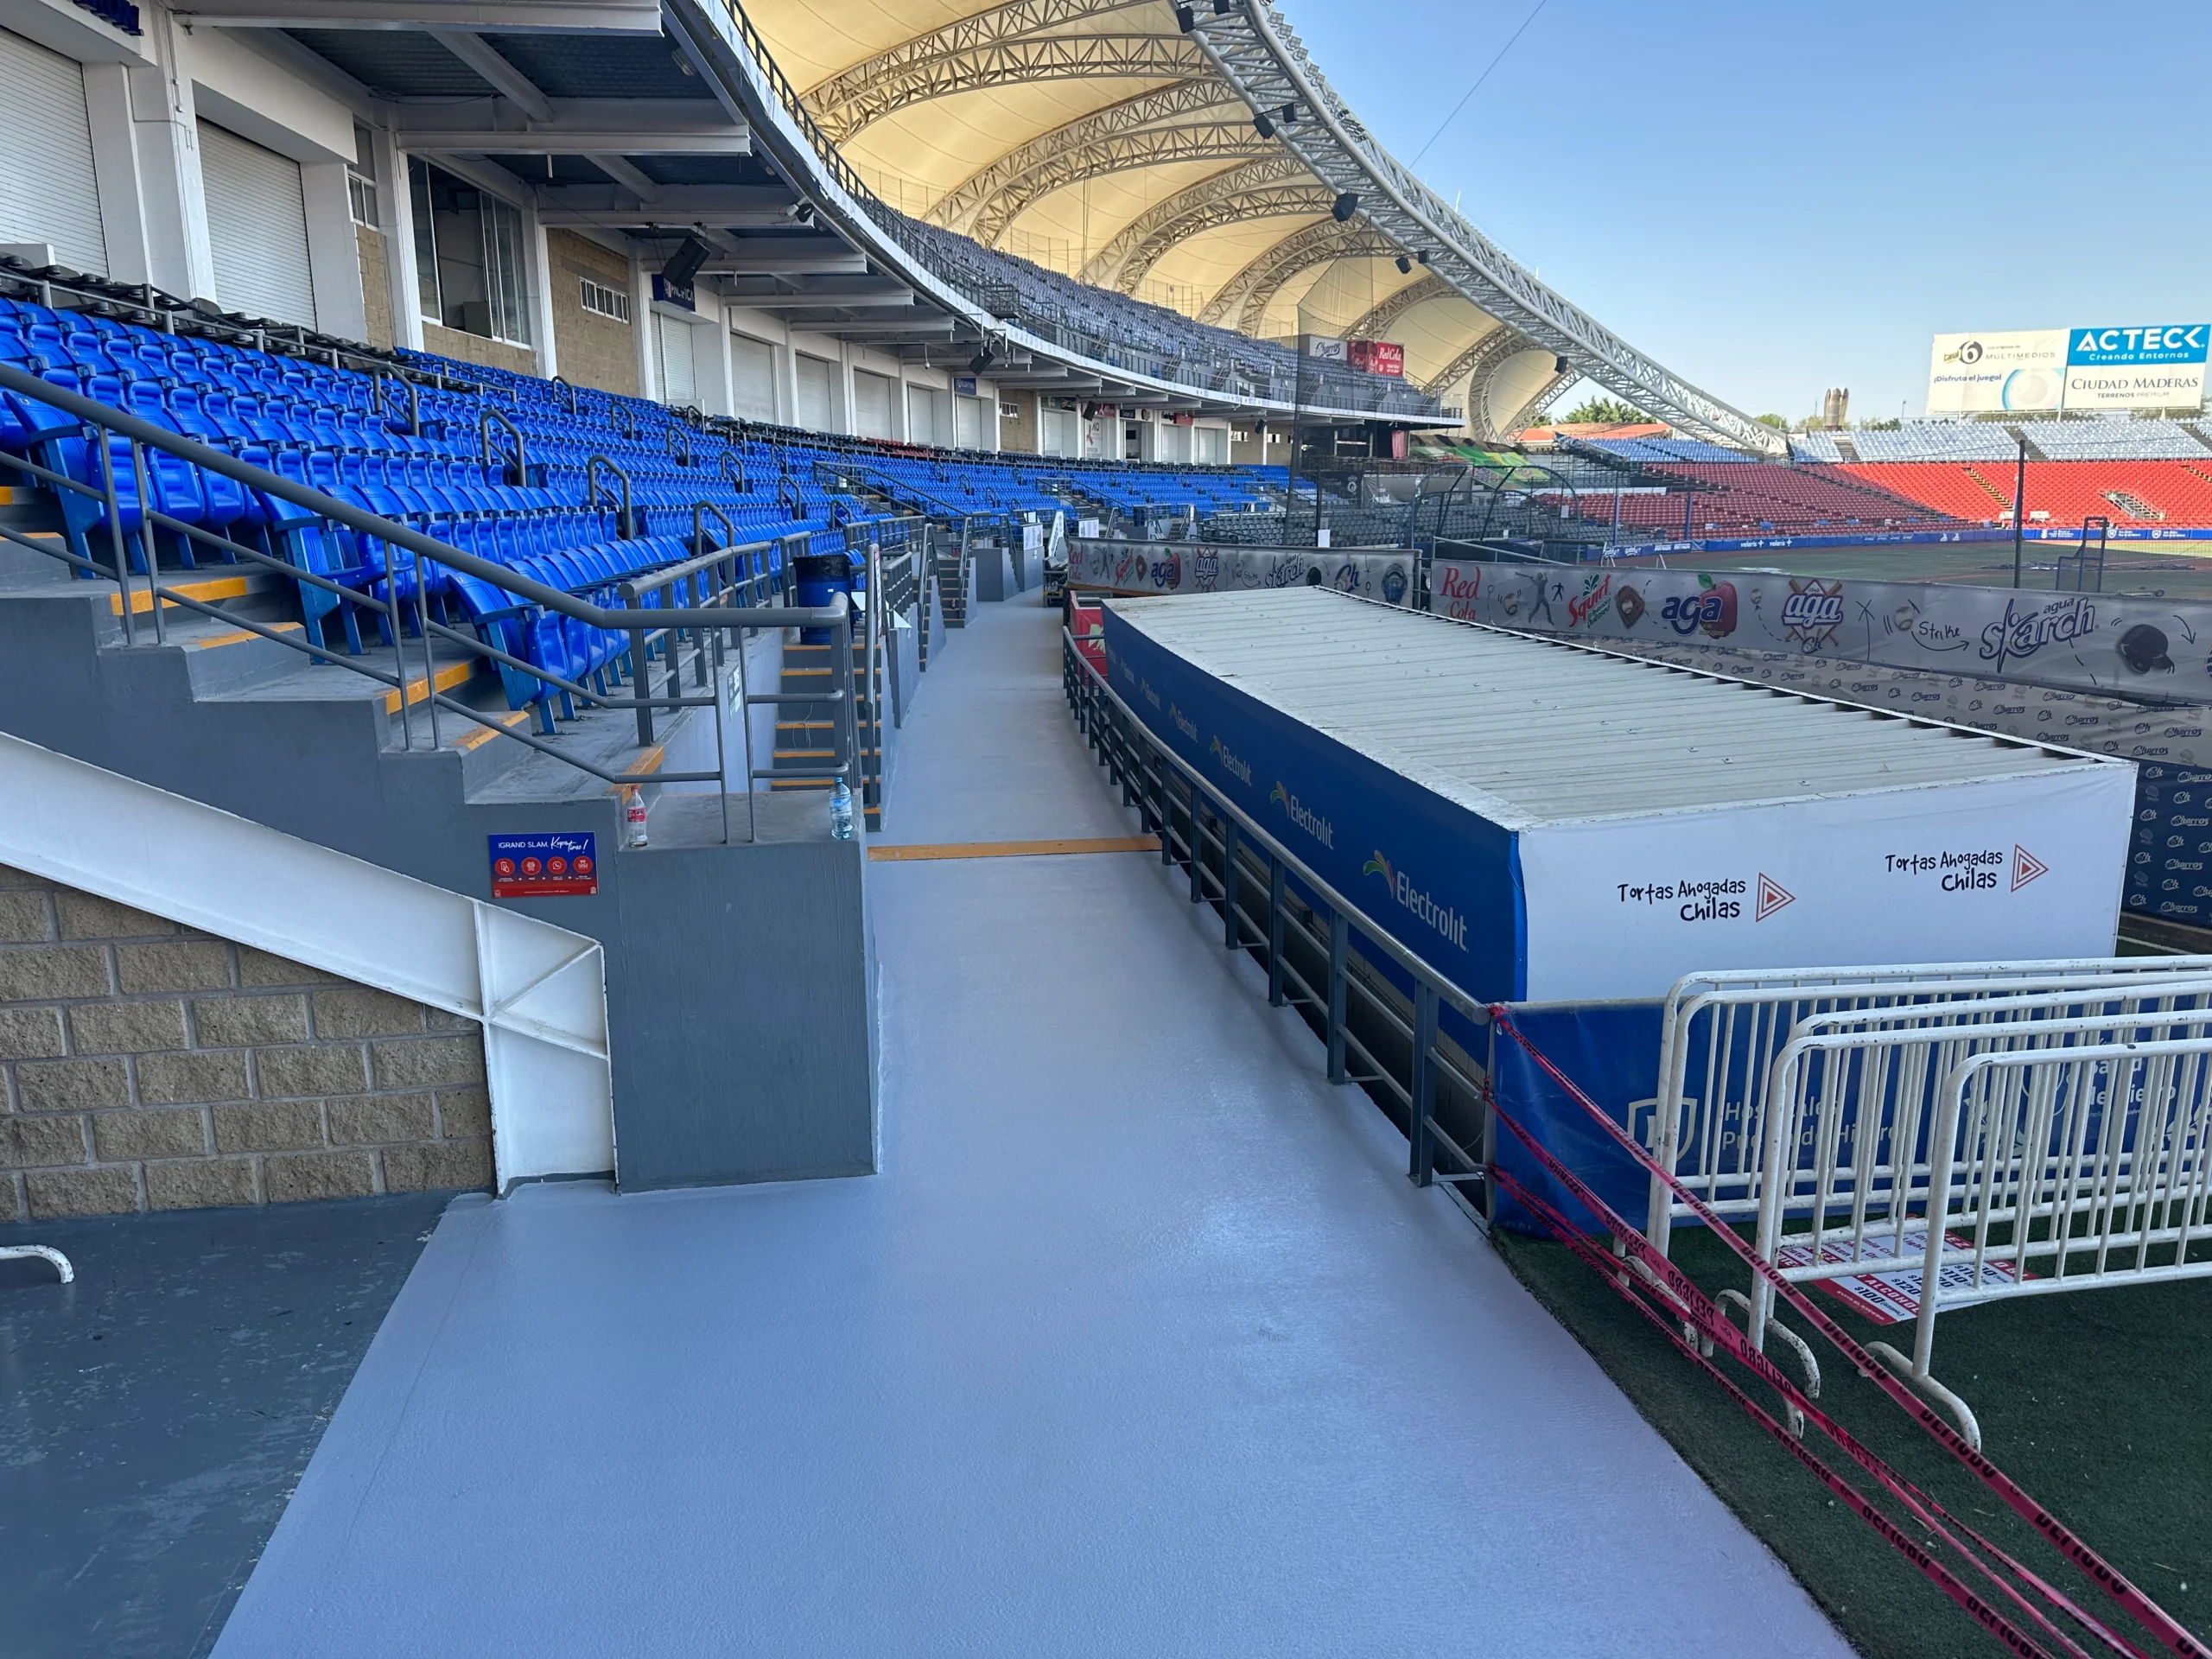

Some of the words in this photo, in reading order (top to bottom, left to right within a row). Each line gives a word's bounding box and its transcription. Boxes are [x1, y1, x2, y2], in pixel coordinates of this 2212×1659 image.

[2075, 327, 2205, 352] ACTECK
[1986, 352, 2056, 360] MULTIMEDIOS
[1195, 556, 1218, 578] aga
[1151, 562, 1175, 588] aga
[1439, 567, 1481, 600] Red
[1567, 573, 1611, 628] Squirt
[2043, 598, 2075, 614] agua
[1450, 601, 1477, 620] Cola
[1661, 596, 1722, 636] aga
[1782, 594, 1843, 629] aga
[1801, 636, 1823, 654] Ch
[1780, 671, 1805, 681] Charros
[1851, 682, 1878, 692] Charros
[1911, 691, 1941, 702] Charros
[1968, 700, 1983, 711] Ch
[1993, 704, 2026, 715] Charros
[2037, 709, 2052, 721] Ch
[2064, 715, 2100, 726] Charros
[1179, 710, 1198, 743] Electrolit
[2134, 722, 2152, 734] Ch
[2164, 727, 2202, 739] Charros
[2037, 732, 2069, 742] Charros
[2103, 741, 2120, 753] Ch
[2133, 745, 2170, 757] Charros
[1224, 746, 1252, 787] Electrolit
[2145, 766, 2164, 779] Ch
[2177, 771, 2212, 783] Charro
[2172, 791, 2191, 804] Ch
[2139, 809, 2158, 821] Ch
[2171, 815, 2209, 826] Charros
[1290, 794, 1334, 851] Electrolit
[2166, 835, 2184, 848] Ch
[1885, 853, 1936, 874] Tortas
[1939, 849, 2004, 869] Ahogadas
[2134, 851, 2152, 864] Ch
[2164, 858, 2203, 870] Charros
[1941, 868, 1998, 893] Chilas
[2161, 878, 2179, 891] Ch
[1618, 883, 1674, 905] Tortas
[1677, 879, 1746, 900] Ahogadas
[2129, 893, 2146, 906] Ch
[1397, 870, 1469, 952] Electrolit
[1680, 899, 1741, 922] Chilas
[2160, 901, 2198, 913] Charros
[1854, 1286, 1886, 1304] $100
[1866, 1279, 1920, 1313] ALCOHOL
